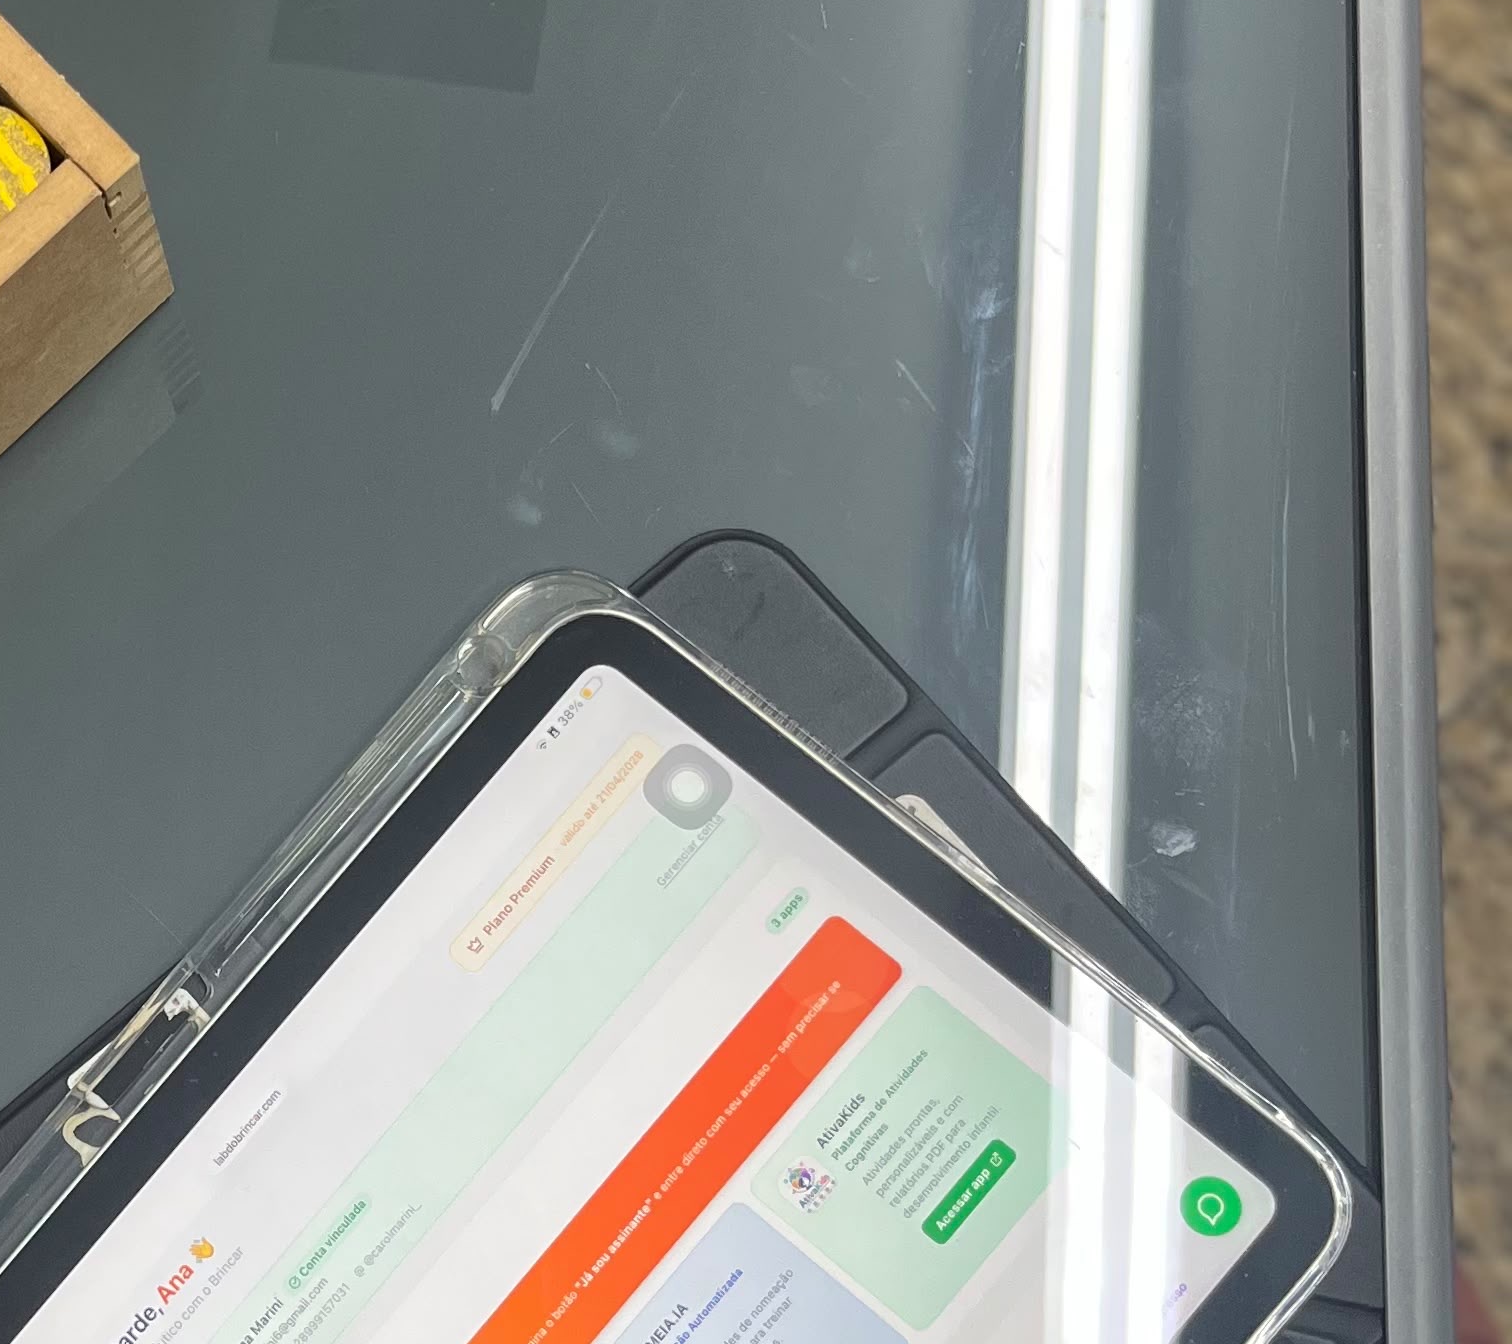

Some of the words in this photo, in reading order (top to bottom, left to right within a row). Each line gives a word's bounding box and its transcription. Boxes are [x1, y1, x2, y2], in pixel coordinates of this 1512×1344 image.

[557, 700, 584, 727] 38%
[656, 839, 700, 887] Gerenciar
[481, 904, 514, 936] Plano
[508, 855, 556, 905] Premium
[770, 917, 782, 929] 3
[779, 894, 804, 920] apps
[212, 1090, 282, 1167] labdobrincar.com
[590, 1252, 611, 1274] sou
[659, 1165, 685, 1193] entre
[681, 1137, 708, 1167] direto
[705, 1115, 727, 1139] com
[723, 1096, 743, 1117] seu
[739, 1063, 771, 1099] acesso
[777, 1031, 798, 1054] sem
[794, 992, 830, 1035] precisar
[827, 980, 841, 995] se
[816, 1093, 866, 1150] AtivaKids
[830, 1110, 877, 1161] Plataforma
[874, 1097, 888, 1112] de
[884, 1049, 929, 1099] Atividades
[844, 1123, 889, 1172] Cognitivas
[861, 1135, 907, 1187] Atividades
[875, 1124, 939, 1200] personalizáveis
[943, 1094, 964, 1118] com
[888, 1162, 930, 1208] relatórios
[924, 1139, 945, 1164] PDF
[944, 1119, 967, 1145] para
[903, 1140, 972, 1219] desenvolvimento
[935, 1188, 973, 1231] Acessar
[971, 1168, 991, 1191] app
[298, 1246, 328, 1277] Conta
[324, 1200, 367, 1247] vinculada
[156, 1264, 195, 1305] Ana
[181, 1295, 205, 1321] com
[207, 1246, 244, 1287] Brincar
[687, 1268, 744, 1333] Automatizada
[738, 1318, 753, 1333] de
[750, 1269, 794, 1320] nomeação
[762, 1296, 793, 1330] treinar
[249, 1296, 284, 1336] Marini
